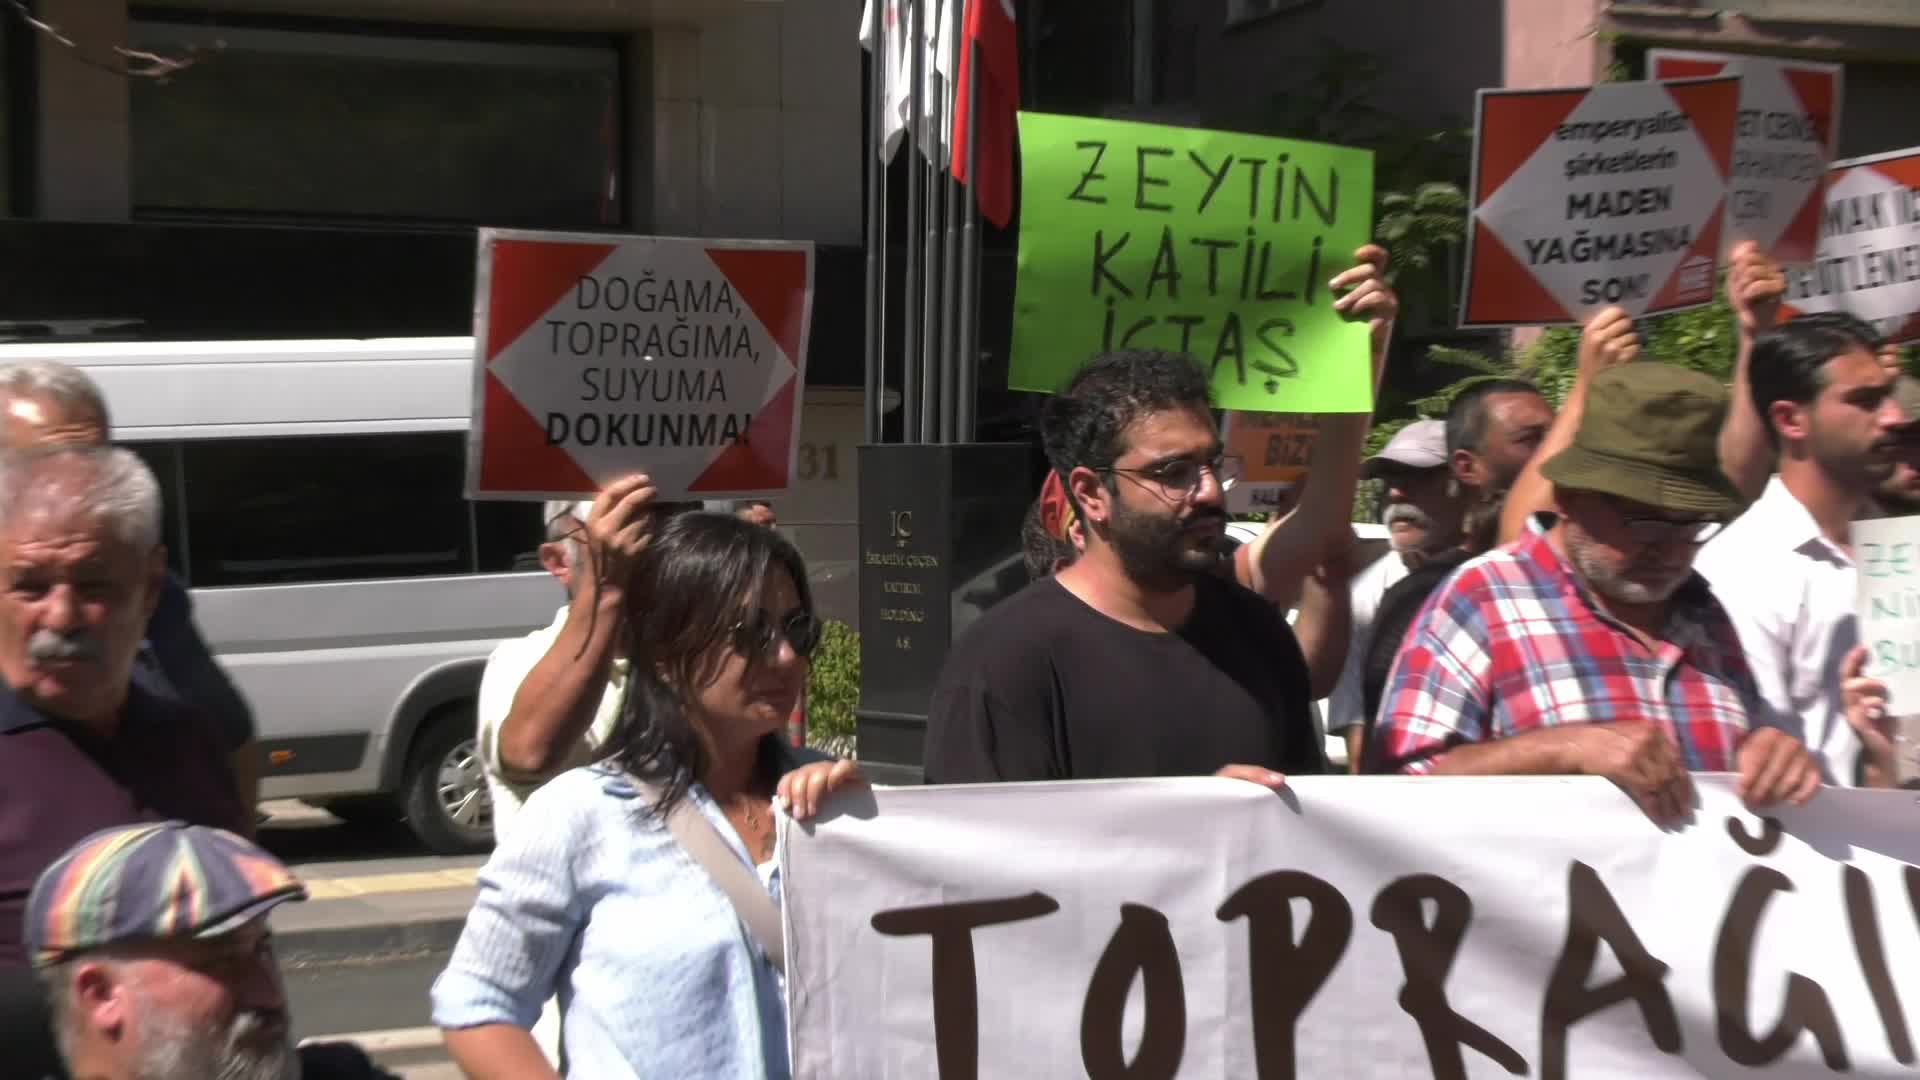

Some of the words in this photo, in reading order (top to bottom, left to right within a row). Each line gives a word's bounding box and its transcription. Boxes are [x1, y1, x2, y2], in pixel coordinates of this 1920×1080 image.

[1067, 141, 1339, 227] ZEYTİN
[1564, 146, 1678, 182] şirketlerin
[1565, 184, 1674, 221] MADEN
[1526, 224, 1692, 266] YAĞMASINA
[1091, 225, 1324, 306] KATİLİ
[576, 269, 741, 319] DOĞAMA,
[546, 315, 761, 363] TOPRAĞIMA,
[581, 367, 727, 402] SUYUMA
[545, 411, 752, 447] DOKUNMA!
[798, 442, 839, 481] 31
[1861, 543, 1915, 577] ZE
[870, 814, 1920, 1080] TOPRAĞI
